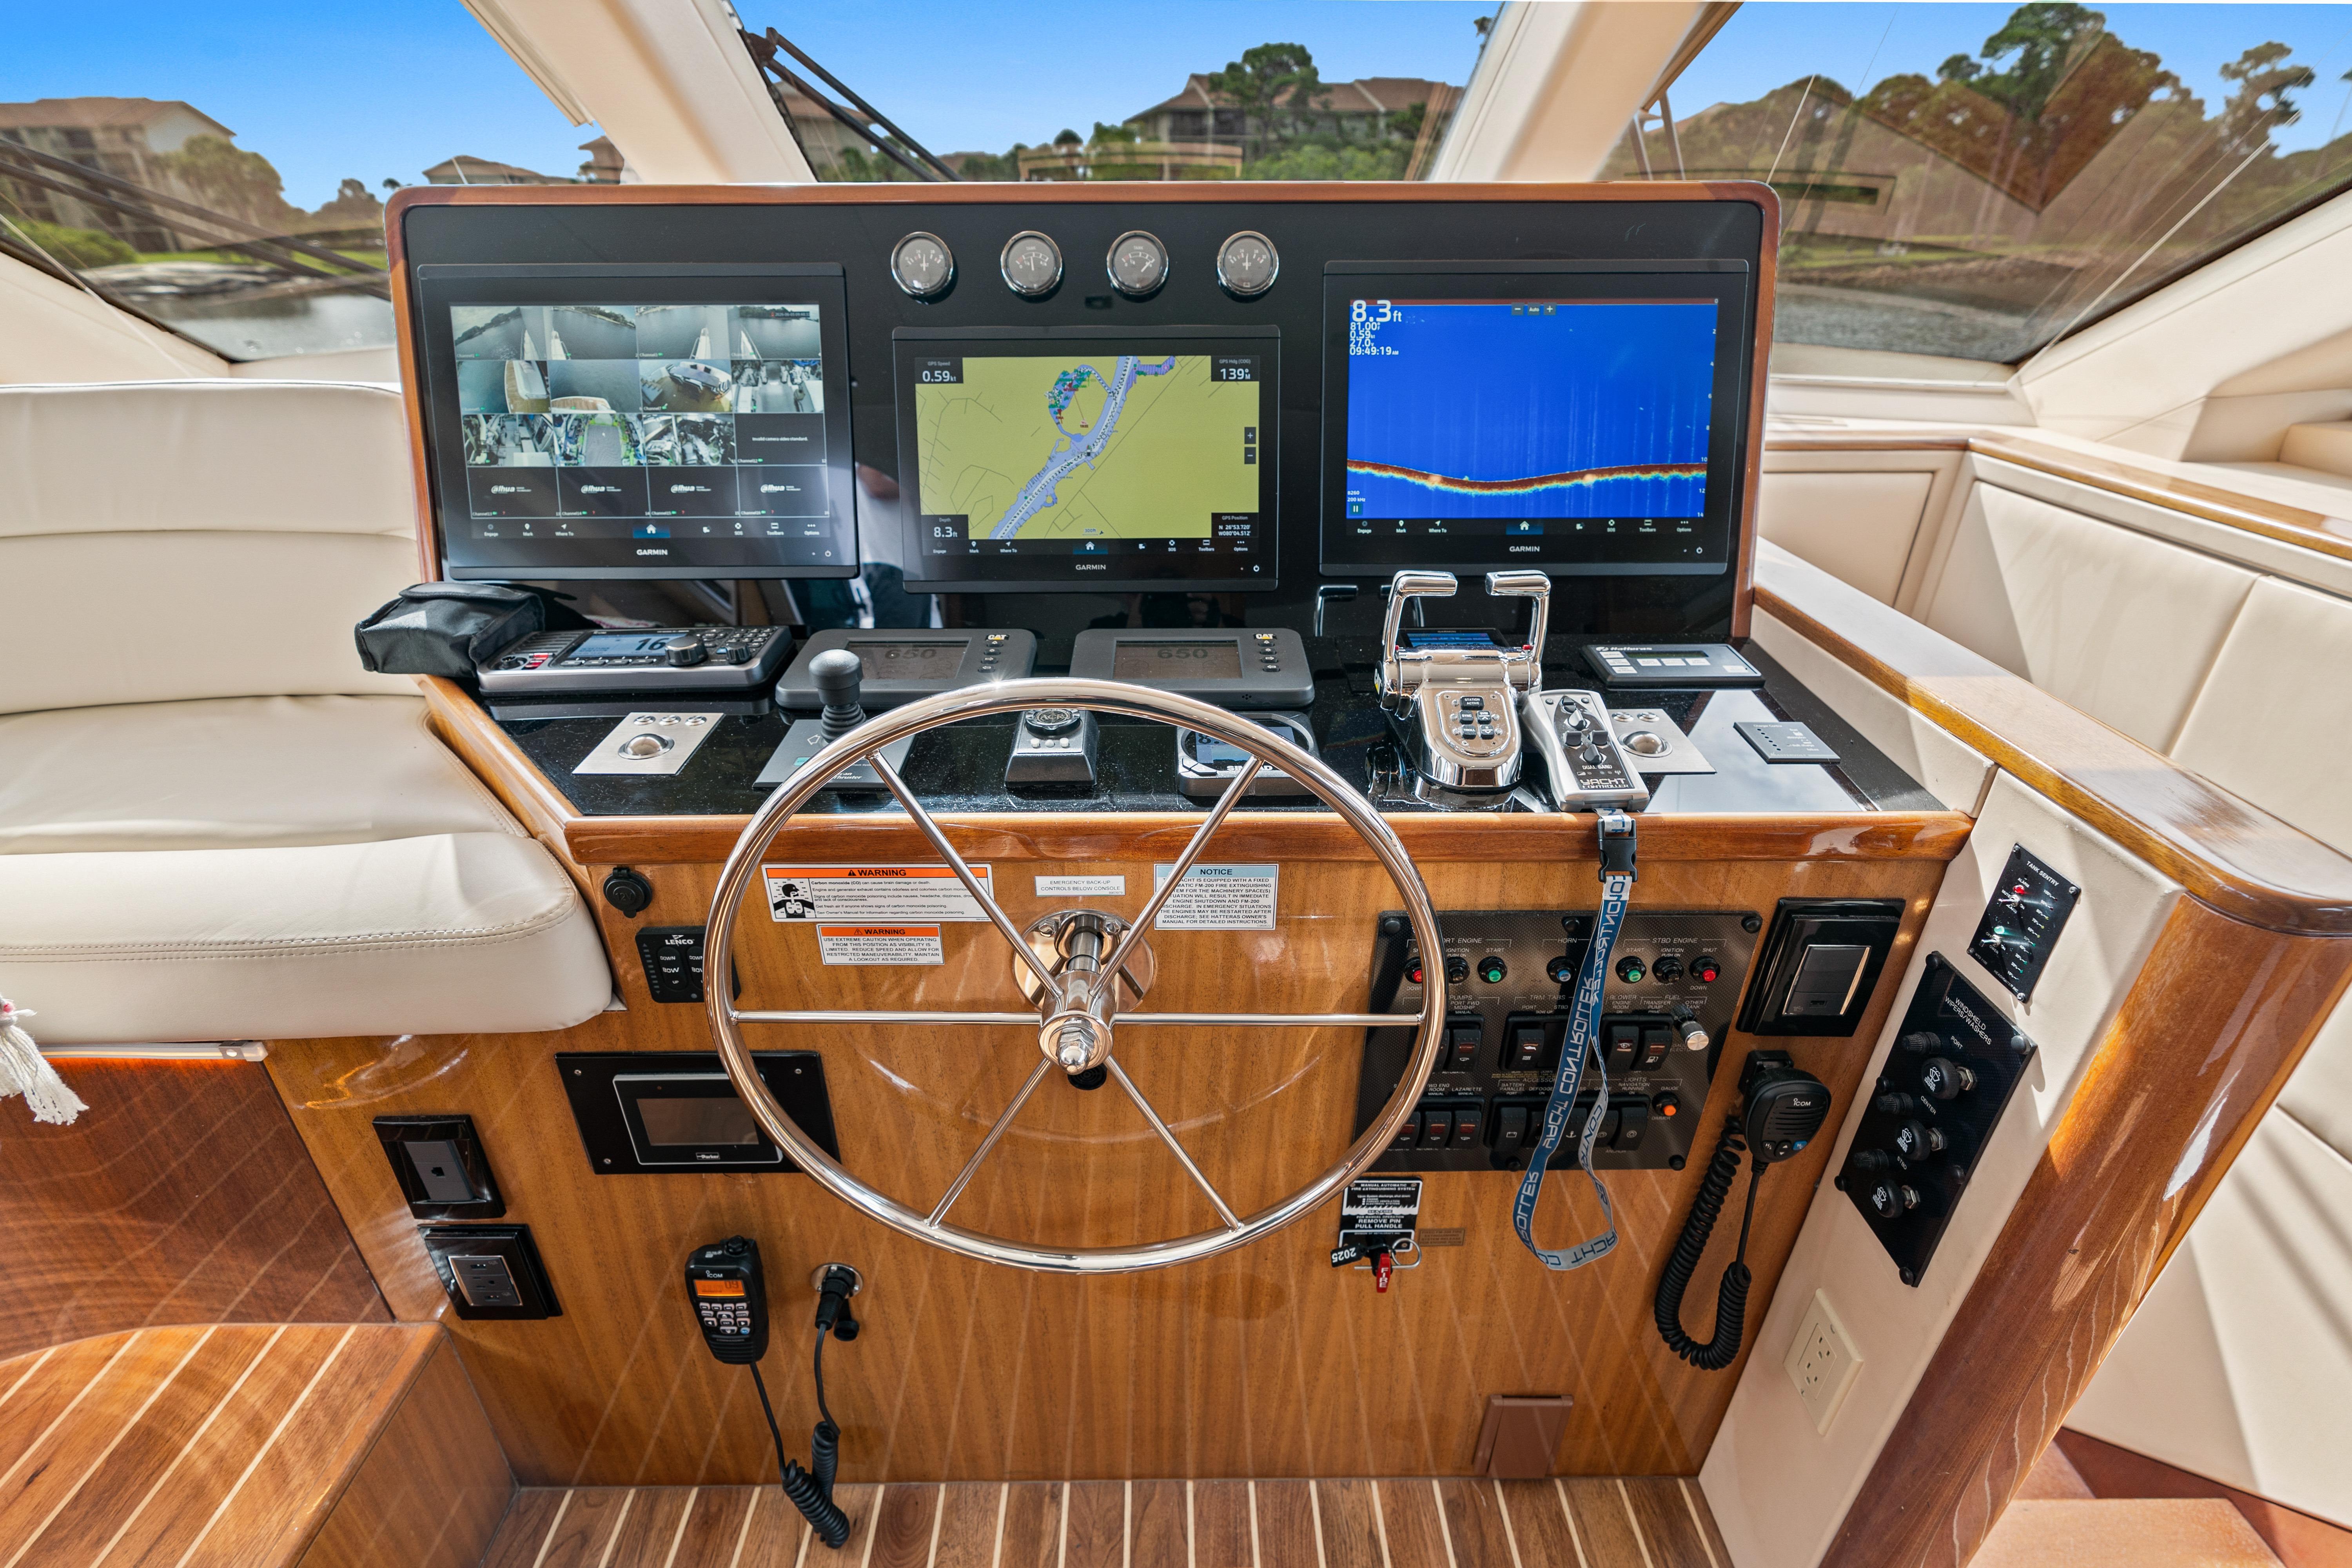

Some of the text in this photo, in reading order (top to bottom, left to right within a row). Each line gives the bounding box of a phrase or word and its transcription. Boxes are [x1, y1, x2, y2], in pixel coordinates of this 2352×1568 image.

[635, 638, 669, 650] 16
[2027, 860, 2059, 886] TANK SENTRY
[2017, 877, 2030, 888] ALARM
[1945, 996, 1992, 1045] WIPERS/WASHERS
[1955, 997, 1987, 1031] WINDSHIELD
[1951, 1035, 1963, 1049] PORT
[1920, 1096, 1936, 1115] CENTER
[1897, 1156, 1907, 1170] STBD
[1332, 1247, 1356, 1262] 2025
[1379, 1268, 1388, 1288] FIRE
